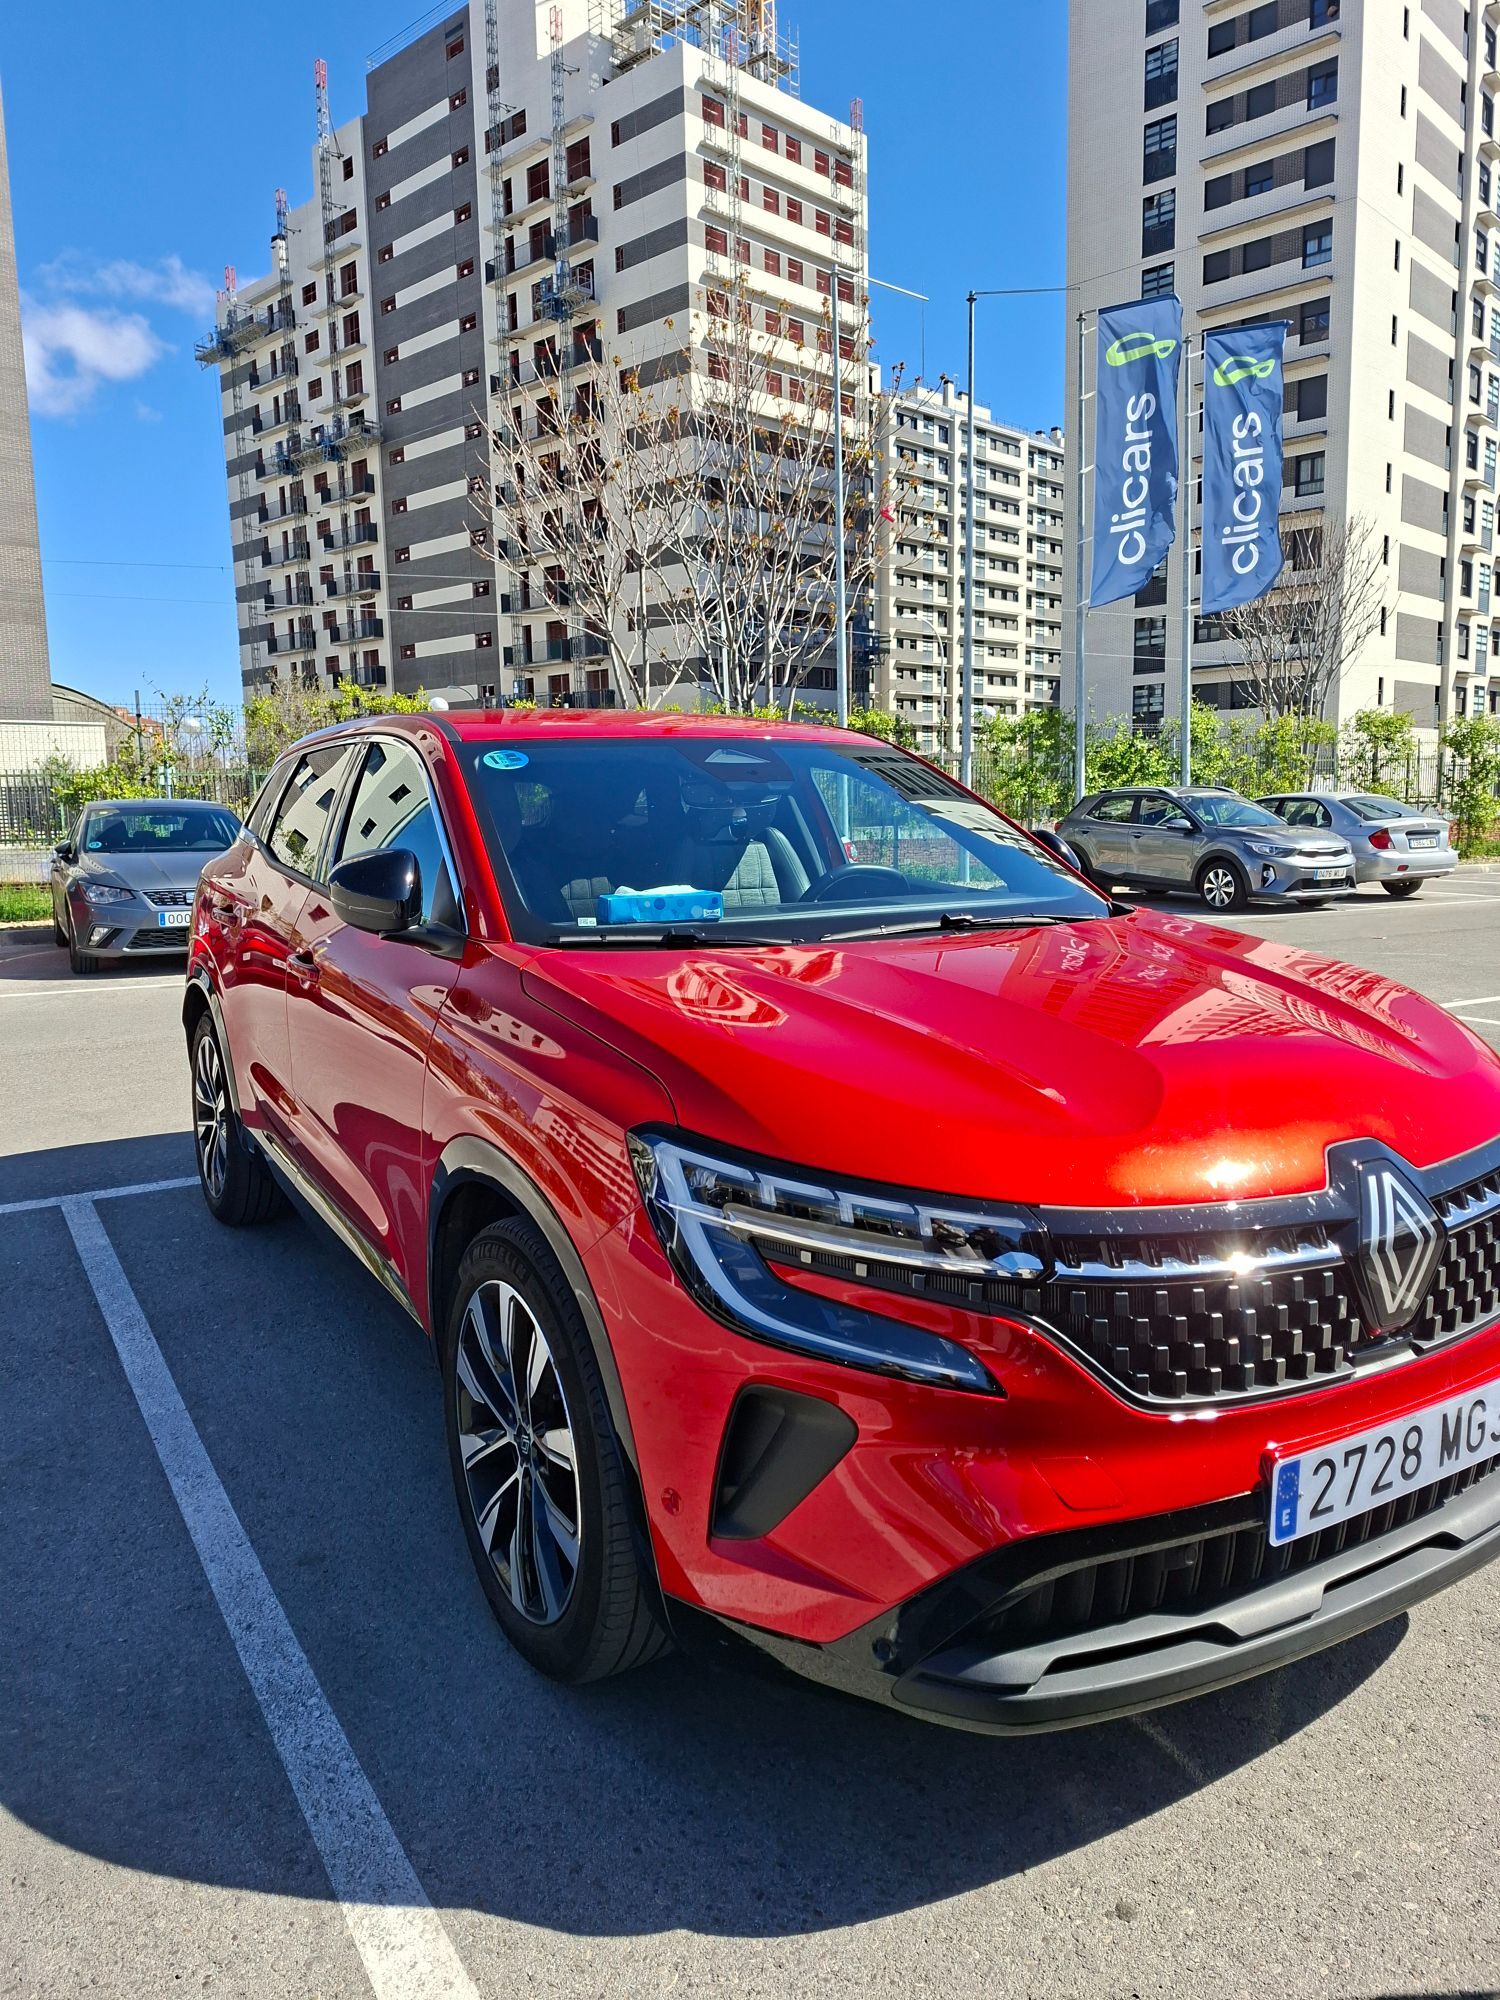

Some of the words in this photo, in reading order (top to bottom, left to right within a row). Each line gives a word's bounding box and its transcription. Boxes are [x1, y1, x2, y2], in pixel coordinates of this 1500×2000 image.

[1110, 393, 1157, 565] clicars
[1222, 412, 1263, 575] clicars
[472, 1243, 530, 1284] MICHELIN
[1281, 1509, 1291, 1527] E
[1309, 1425, 1424, 1520] 2728
